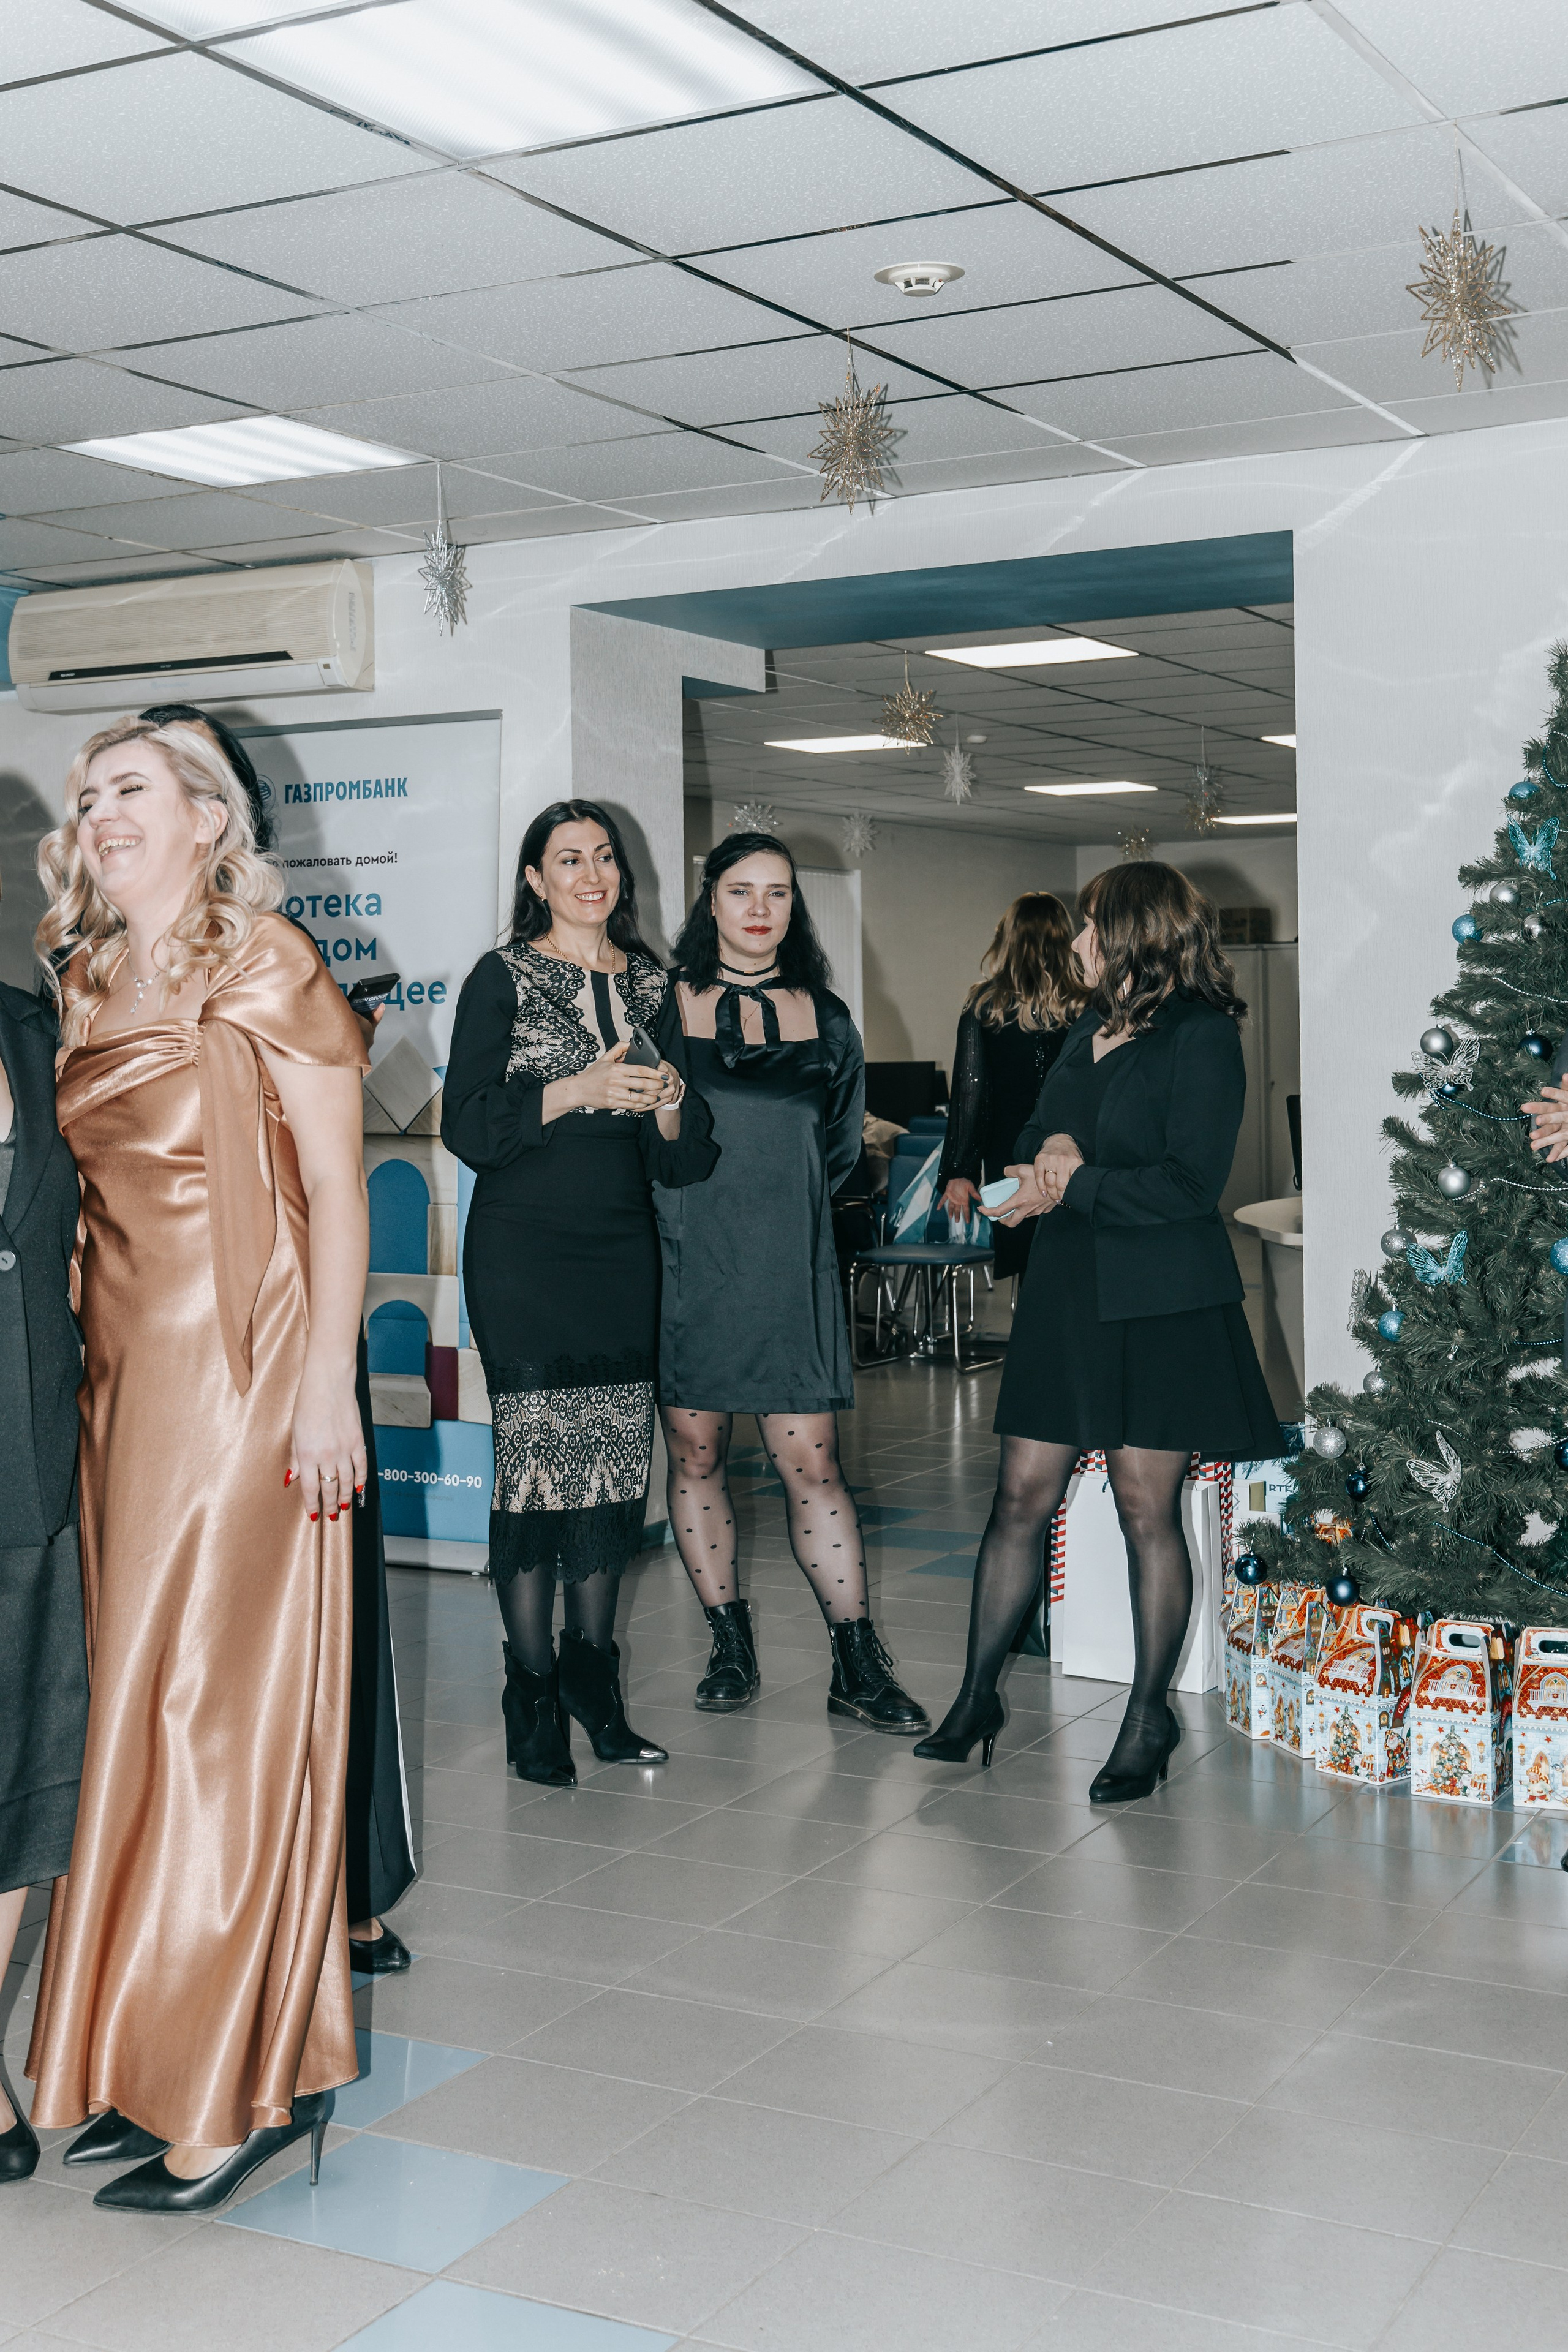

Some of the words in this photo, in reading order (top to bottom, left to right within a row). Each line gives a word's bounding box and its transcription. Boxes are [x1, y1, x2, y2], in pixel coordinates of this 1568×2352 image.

[285, 777, 408, 804] ГАЗПРОМБАНК
[283, 858, 352, 868] пожаловать
[355, 851, 398, 867] домой!
[285, 892, 382, 919] отека
[378, 1468, 483, 1488] -800-300-60-90
